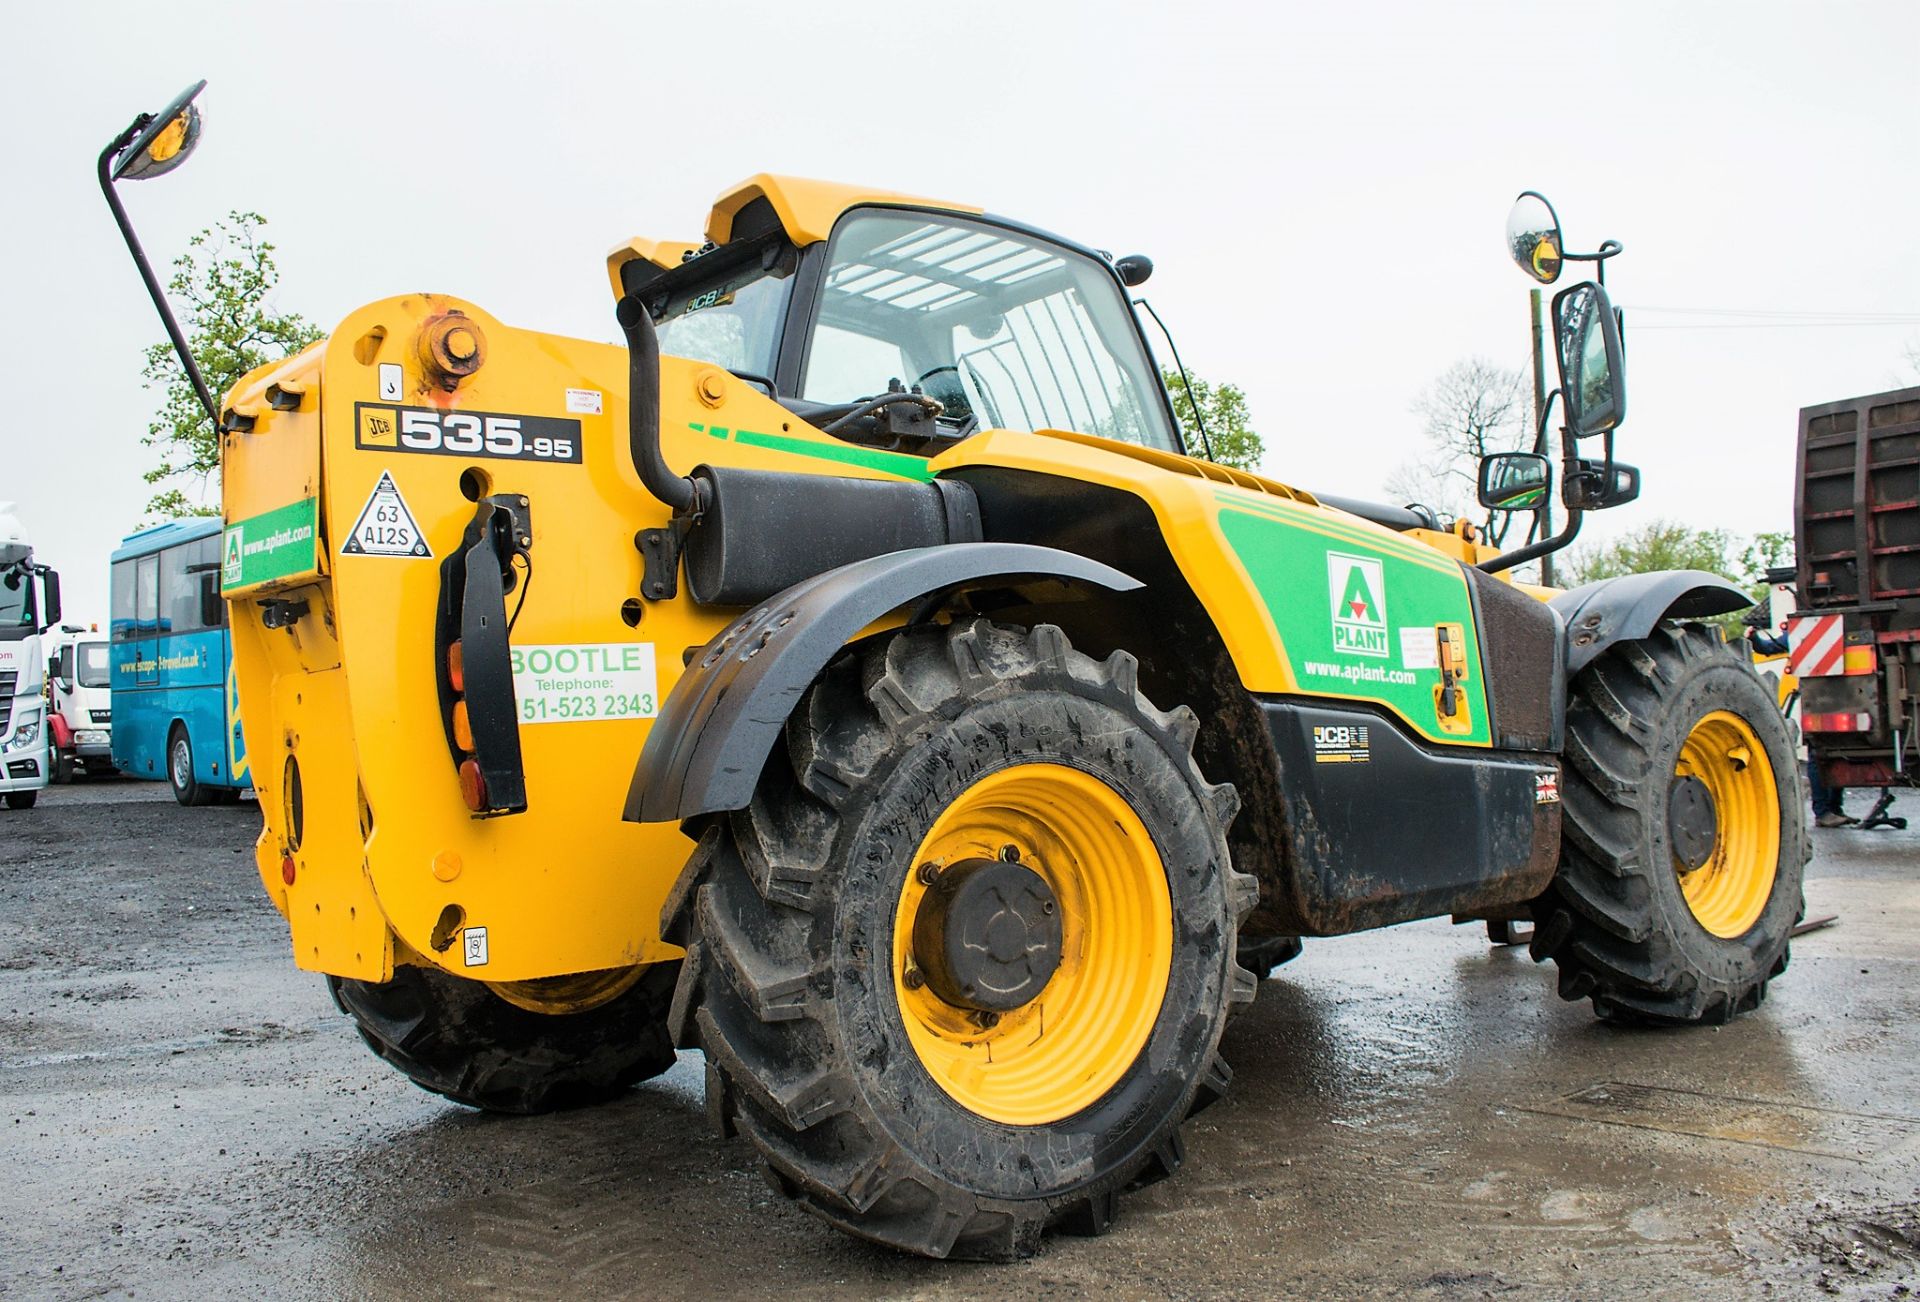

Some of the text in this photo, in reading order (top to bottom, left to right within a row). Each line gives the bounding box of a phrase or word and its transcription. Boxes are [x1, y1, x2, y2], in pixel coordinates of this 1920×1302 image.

[686, 289, 717, 312] JCB
[369, 416, 392, 436] JCB
[401, 410, 573, 458] 535-95
[376, 505, 399, 523] 63
[227, 533, 241, 565] A
[243, 525, 312, 556] www.aplant.com
[1338, 565, 1381, 623] A
[1334, 625, 1386, 651] PLANT
[510, 647, 641, 675] BOOTLE
[1304, 660, 1417, 686] www.aplant.com
[535, 678, 614, 693] Telephone:
[521, 693, 653, 720] 51-523 2343
[1313, 726, 1350, 743] JCB
